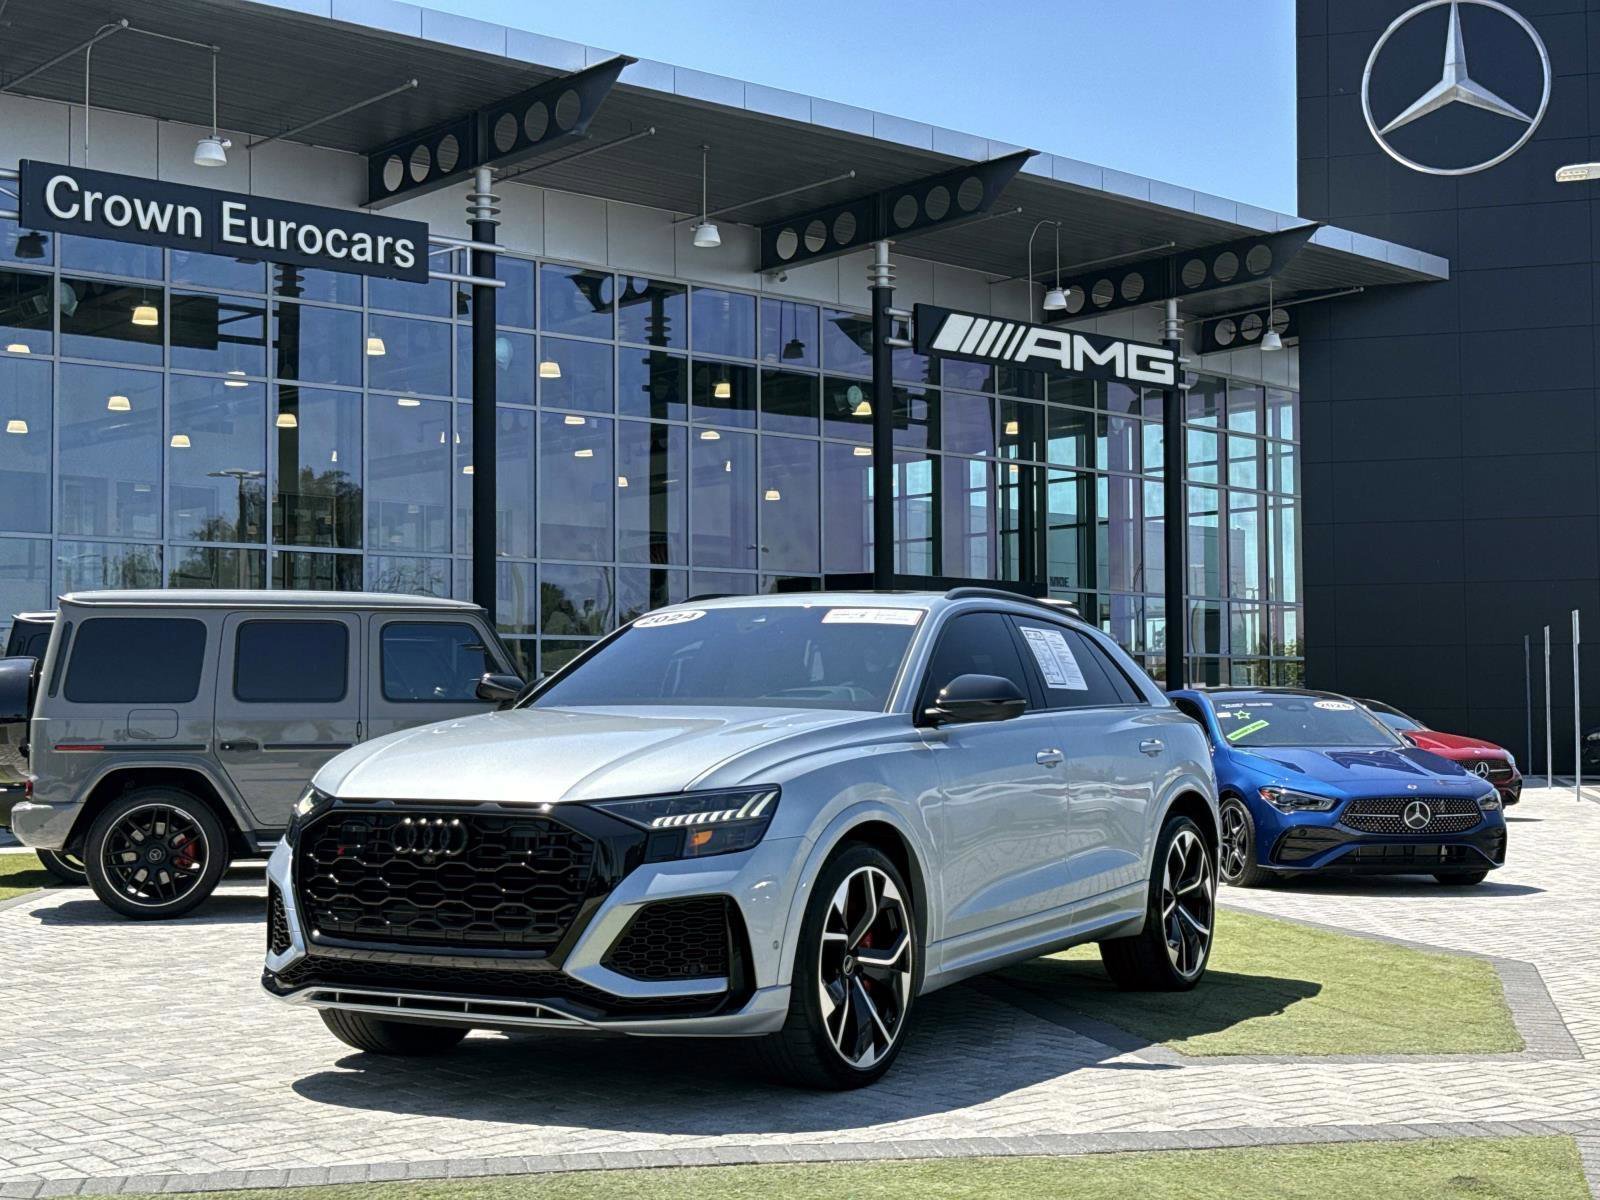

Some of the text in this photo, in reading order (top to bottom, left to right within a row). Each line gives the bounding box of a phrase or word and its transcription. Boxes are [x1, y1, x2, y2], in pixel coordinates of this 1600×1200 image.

[45, 174, 416, 269] Crown Eurocars
[1013, 327, 1175, 386] AMG
